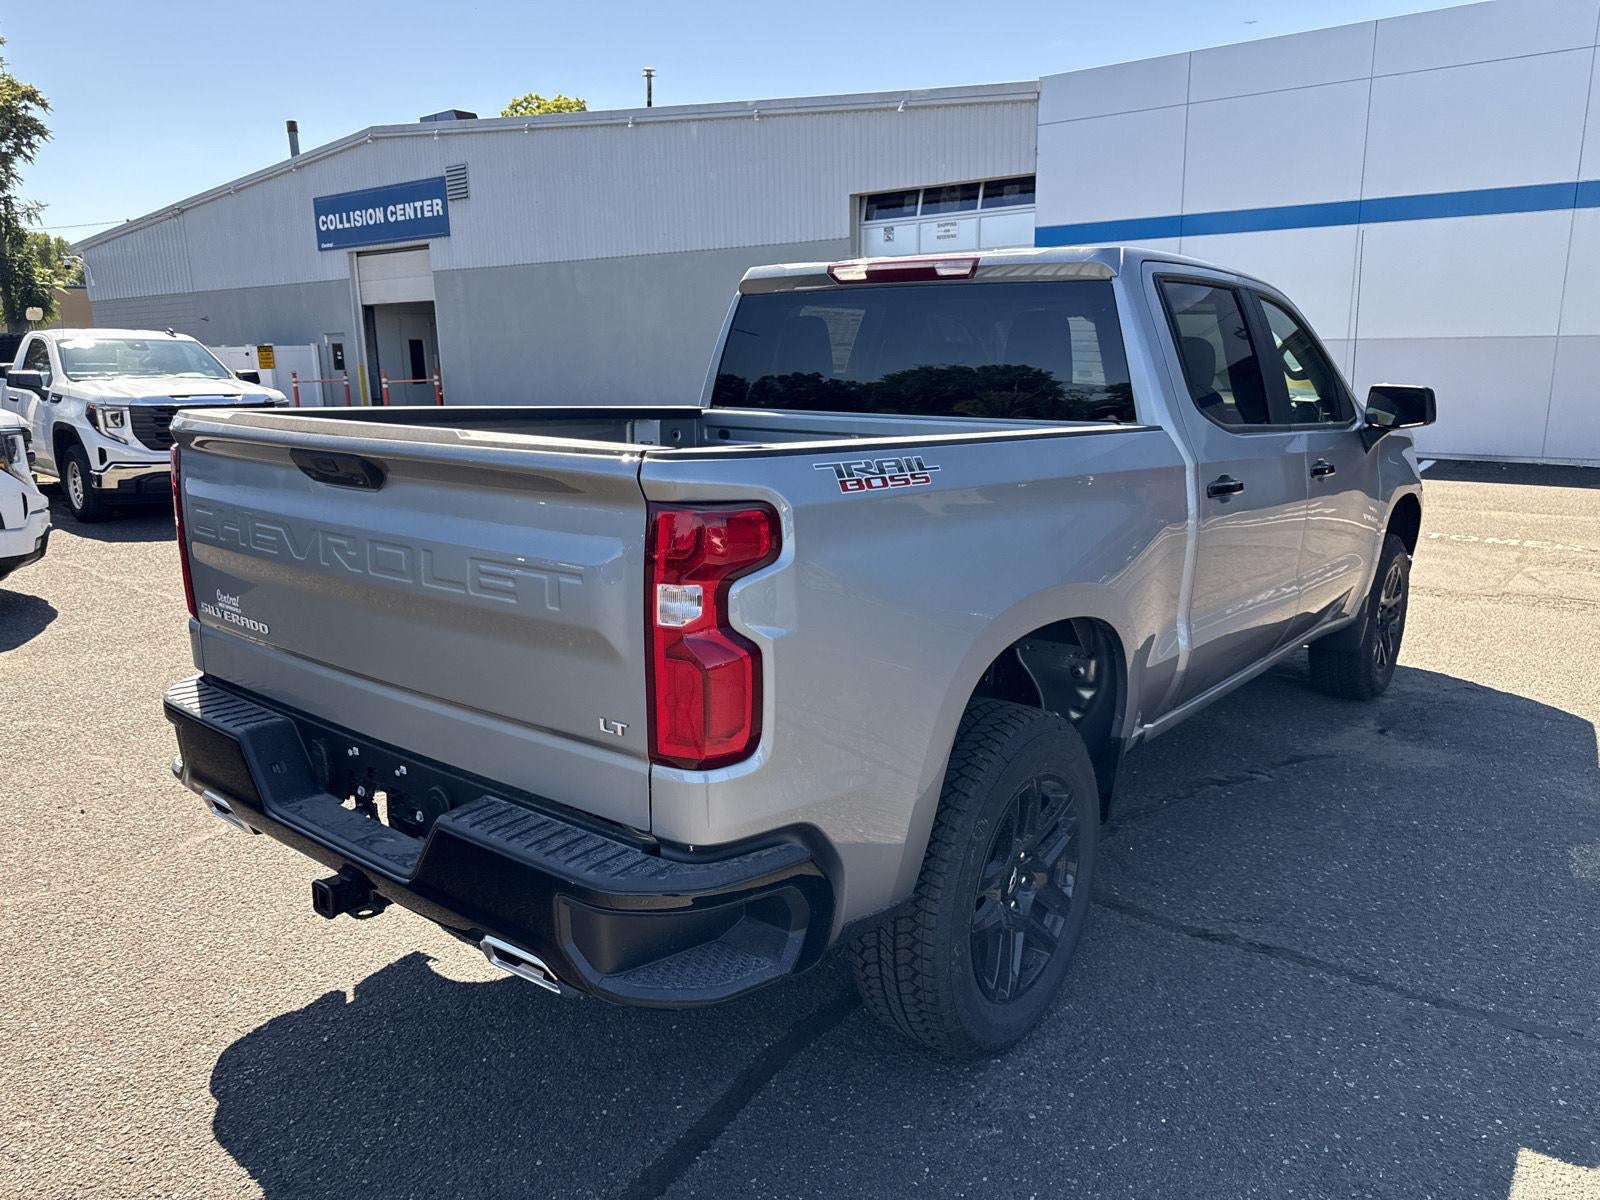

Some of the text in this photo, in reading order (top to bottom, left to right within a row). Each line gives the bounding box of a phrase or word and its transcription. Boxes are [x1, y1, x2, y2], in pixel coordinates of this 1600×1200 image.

[319, 199, 443, 231] COLLISION CENTER
[813, 456, 941, 479] TRAIL
[839, 472, 931, 494] BOSS
[1426, 532, 1586, 552] TOMER
[193, 503, 584, 611] CHEVROLET
[216, 588, 240, 607] Central
[201, 602, 269, 634] SILVERADO
[599, 717, 629, 736] LT
